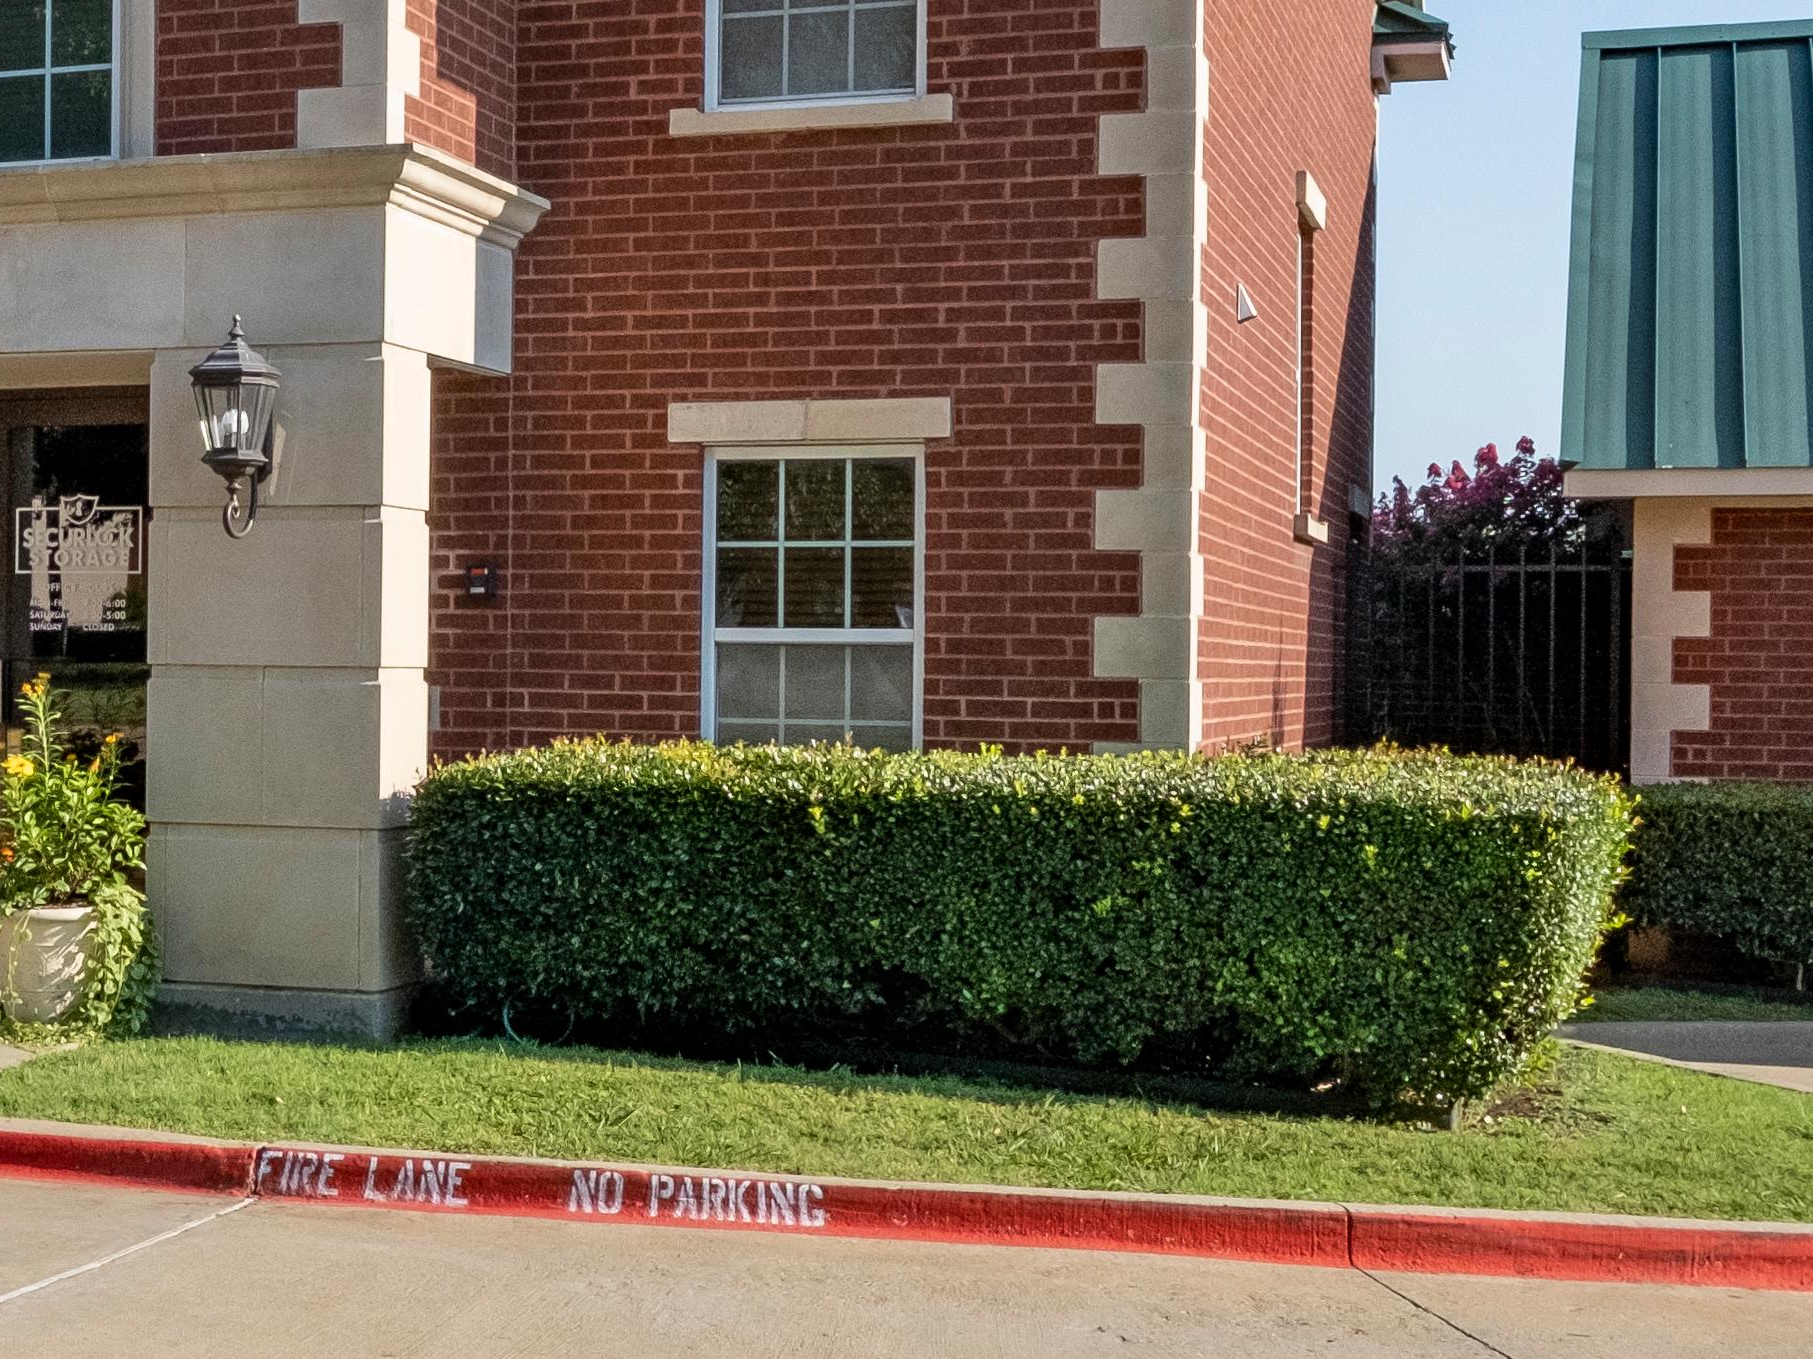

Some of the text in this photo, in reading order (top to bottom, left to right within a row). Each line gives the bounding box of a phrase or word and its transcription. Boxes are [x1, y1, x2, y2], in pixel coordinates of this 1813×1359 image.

[29, 548, 129, 568] STORAGE
[29, 622, 115, 632] SUNDAY CLOSED
[256, 1150, 472, 1207] FIRE LANE
[568, 1169, 826, 1228] NO PARKING
